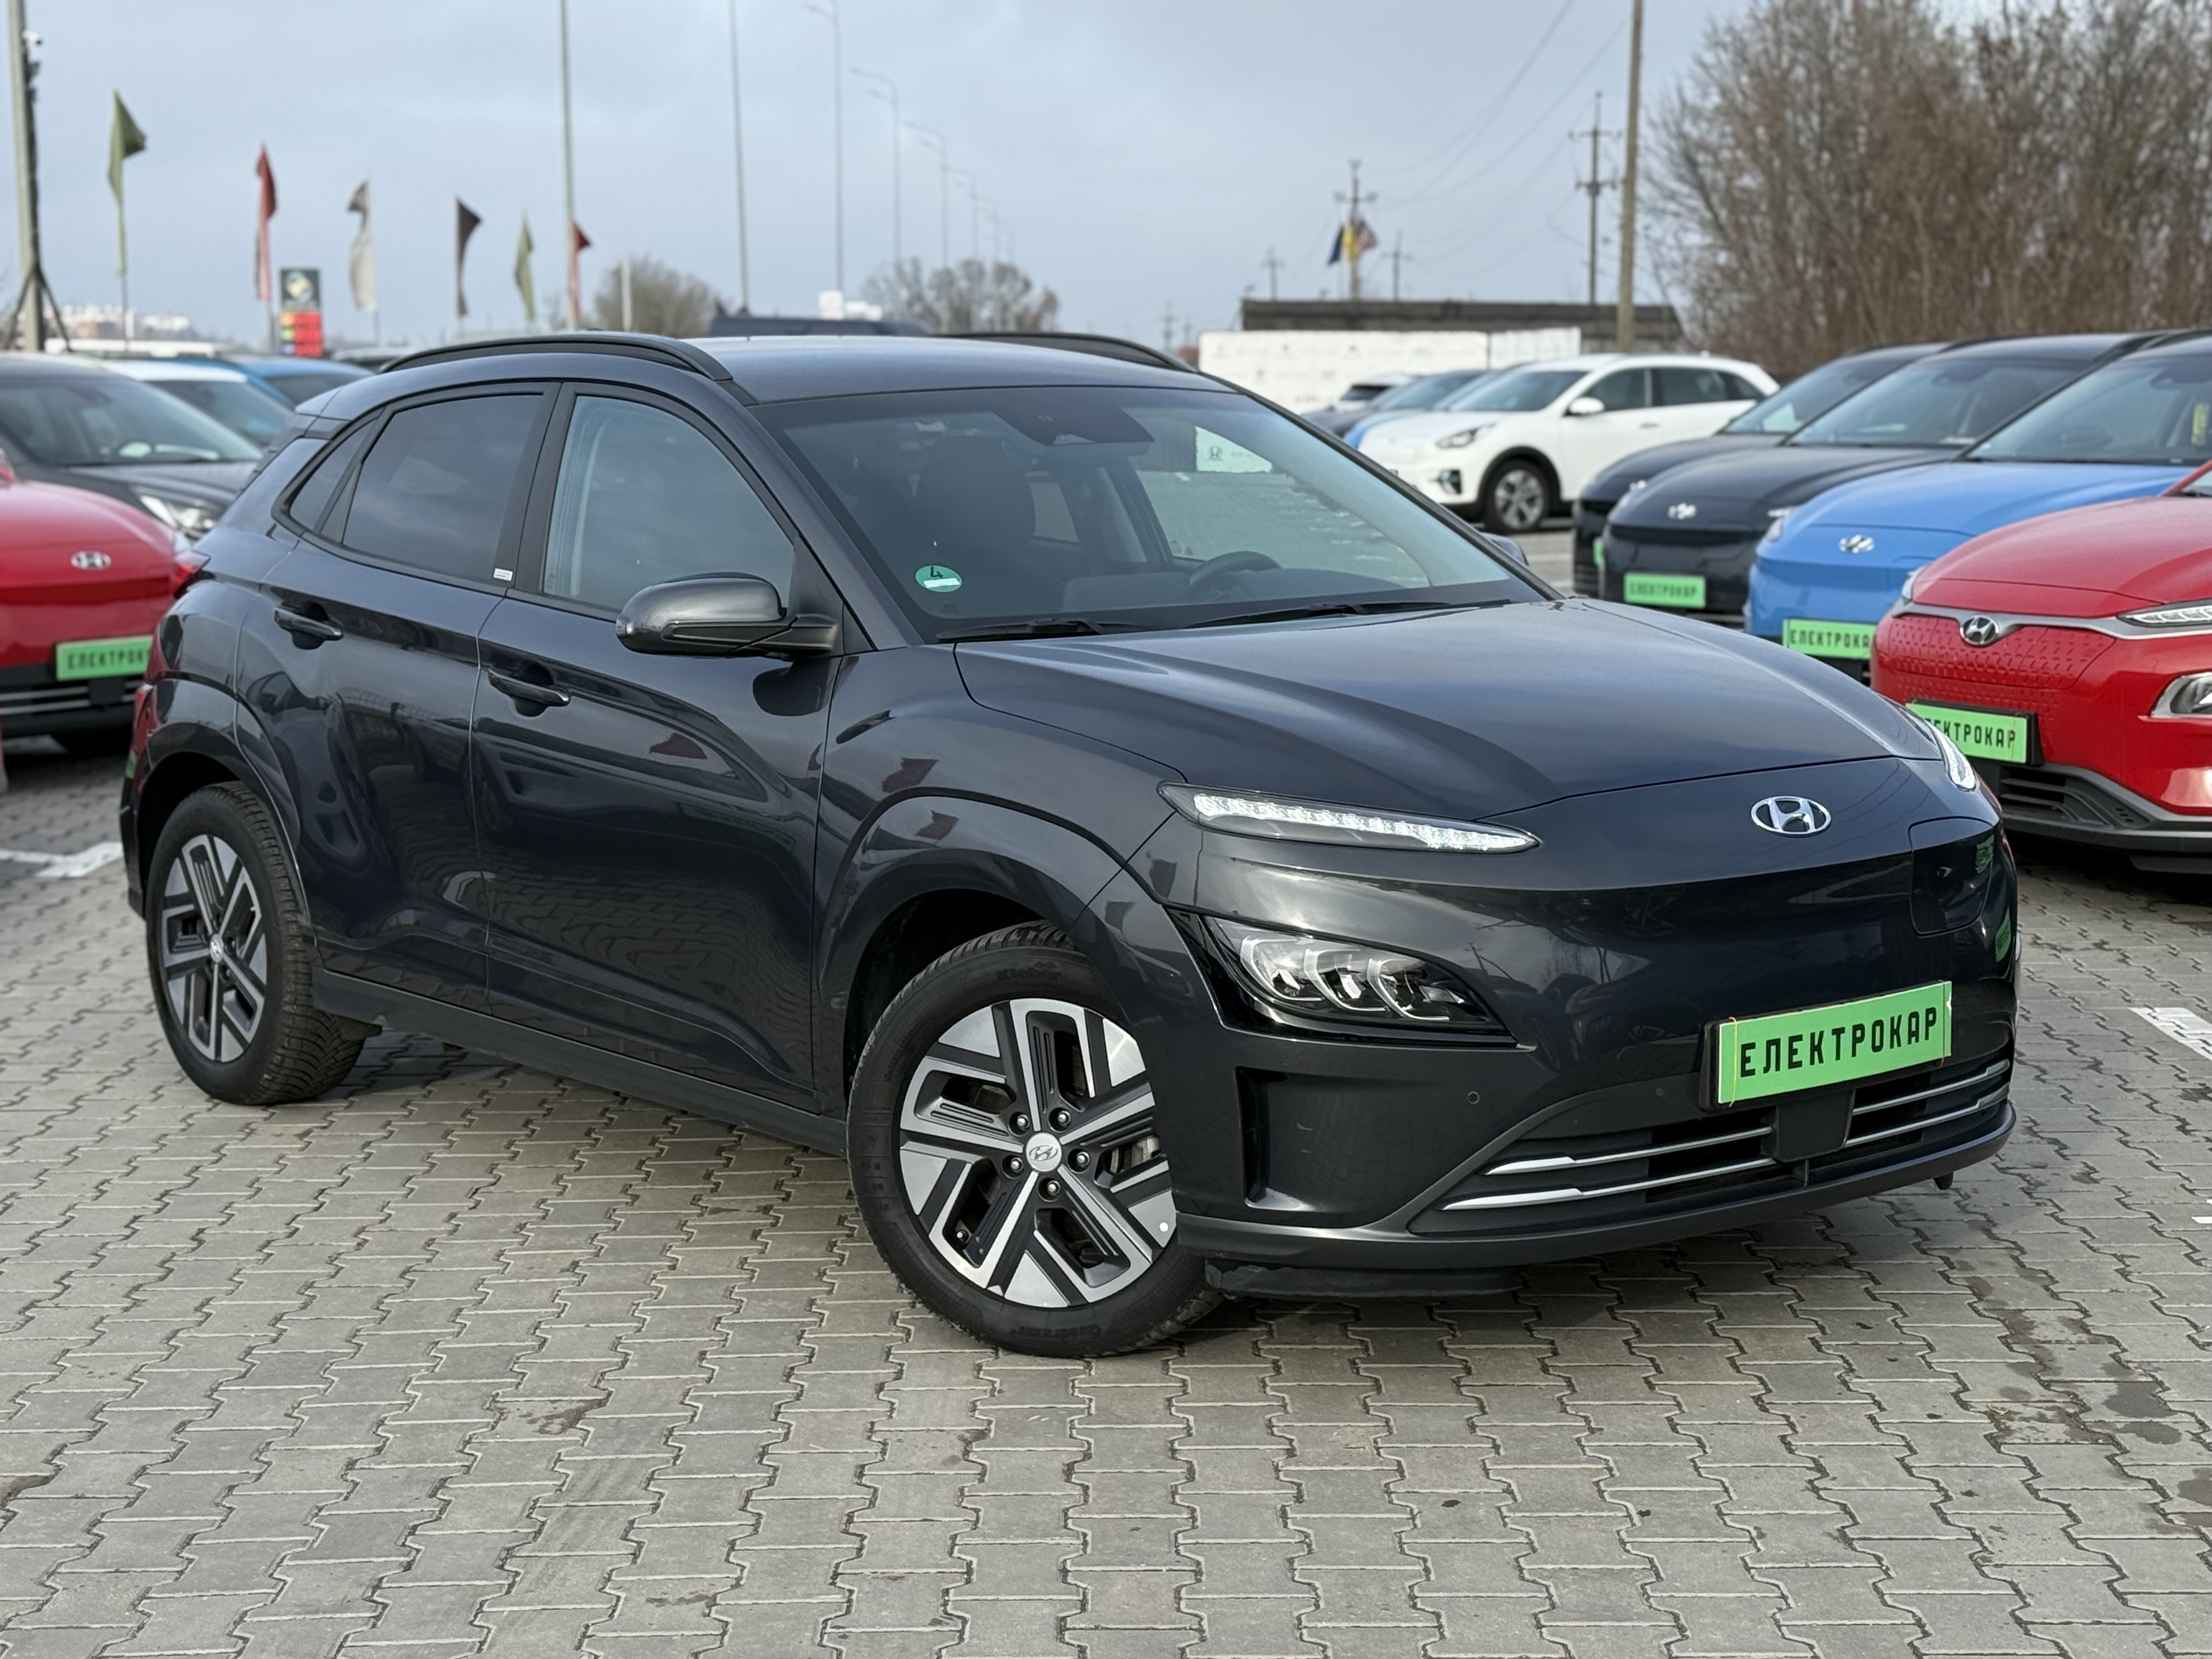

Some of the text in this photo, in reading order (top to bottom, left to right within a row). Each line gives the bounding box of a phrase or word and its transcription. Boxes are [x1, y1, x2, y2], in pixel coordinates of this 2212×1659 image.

[930, 567, 943, 579] 4
[1790, 630, 1869, 648] ЕЛЕКТРОКА
[68, 650, 152, 669] ЕЛЕКТРОК
[996, 967, 1062, 981] Kleber
[1740, 1007, 1937, 1078] ЕЛЕКТРОКАР
